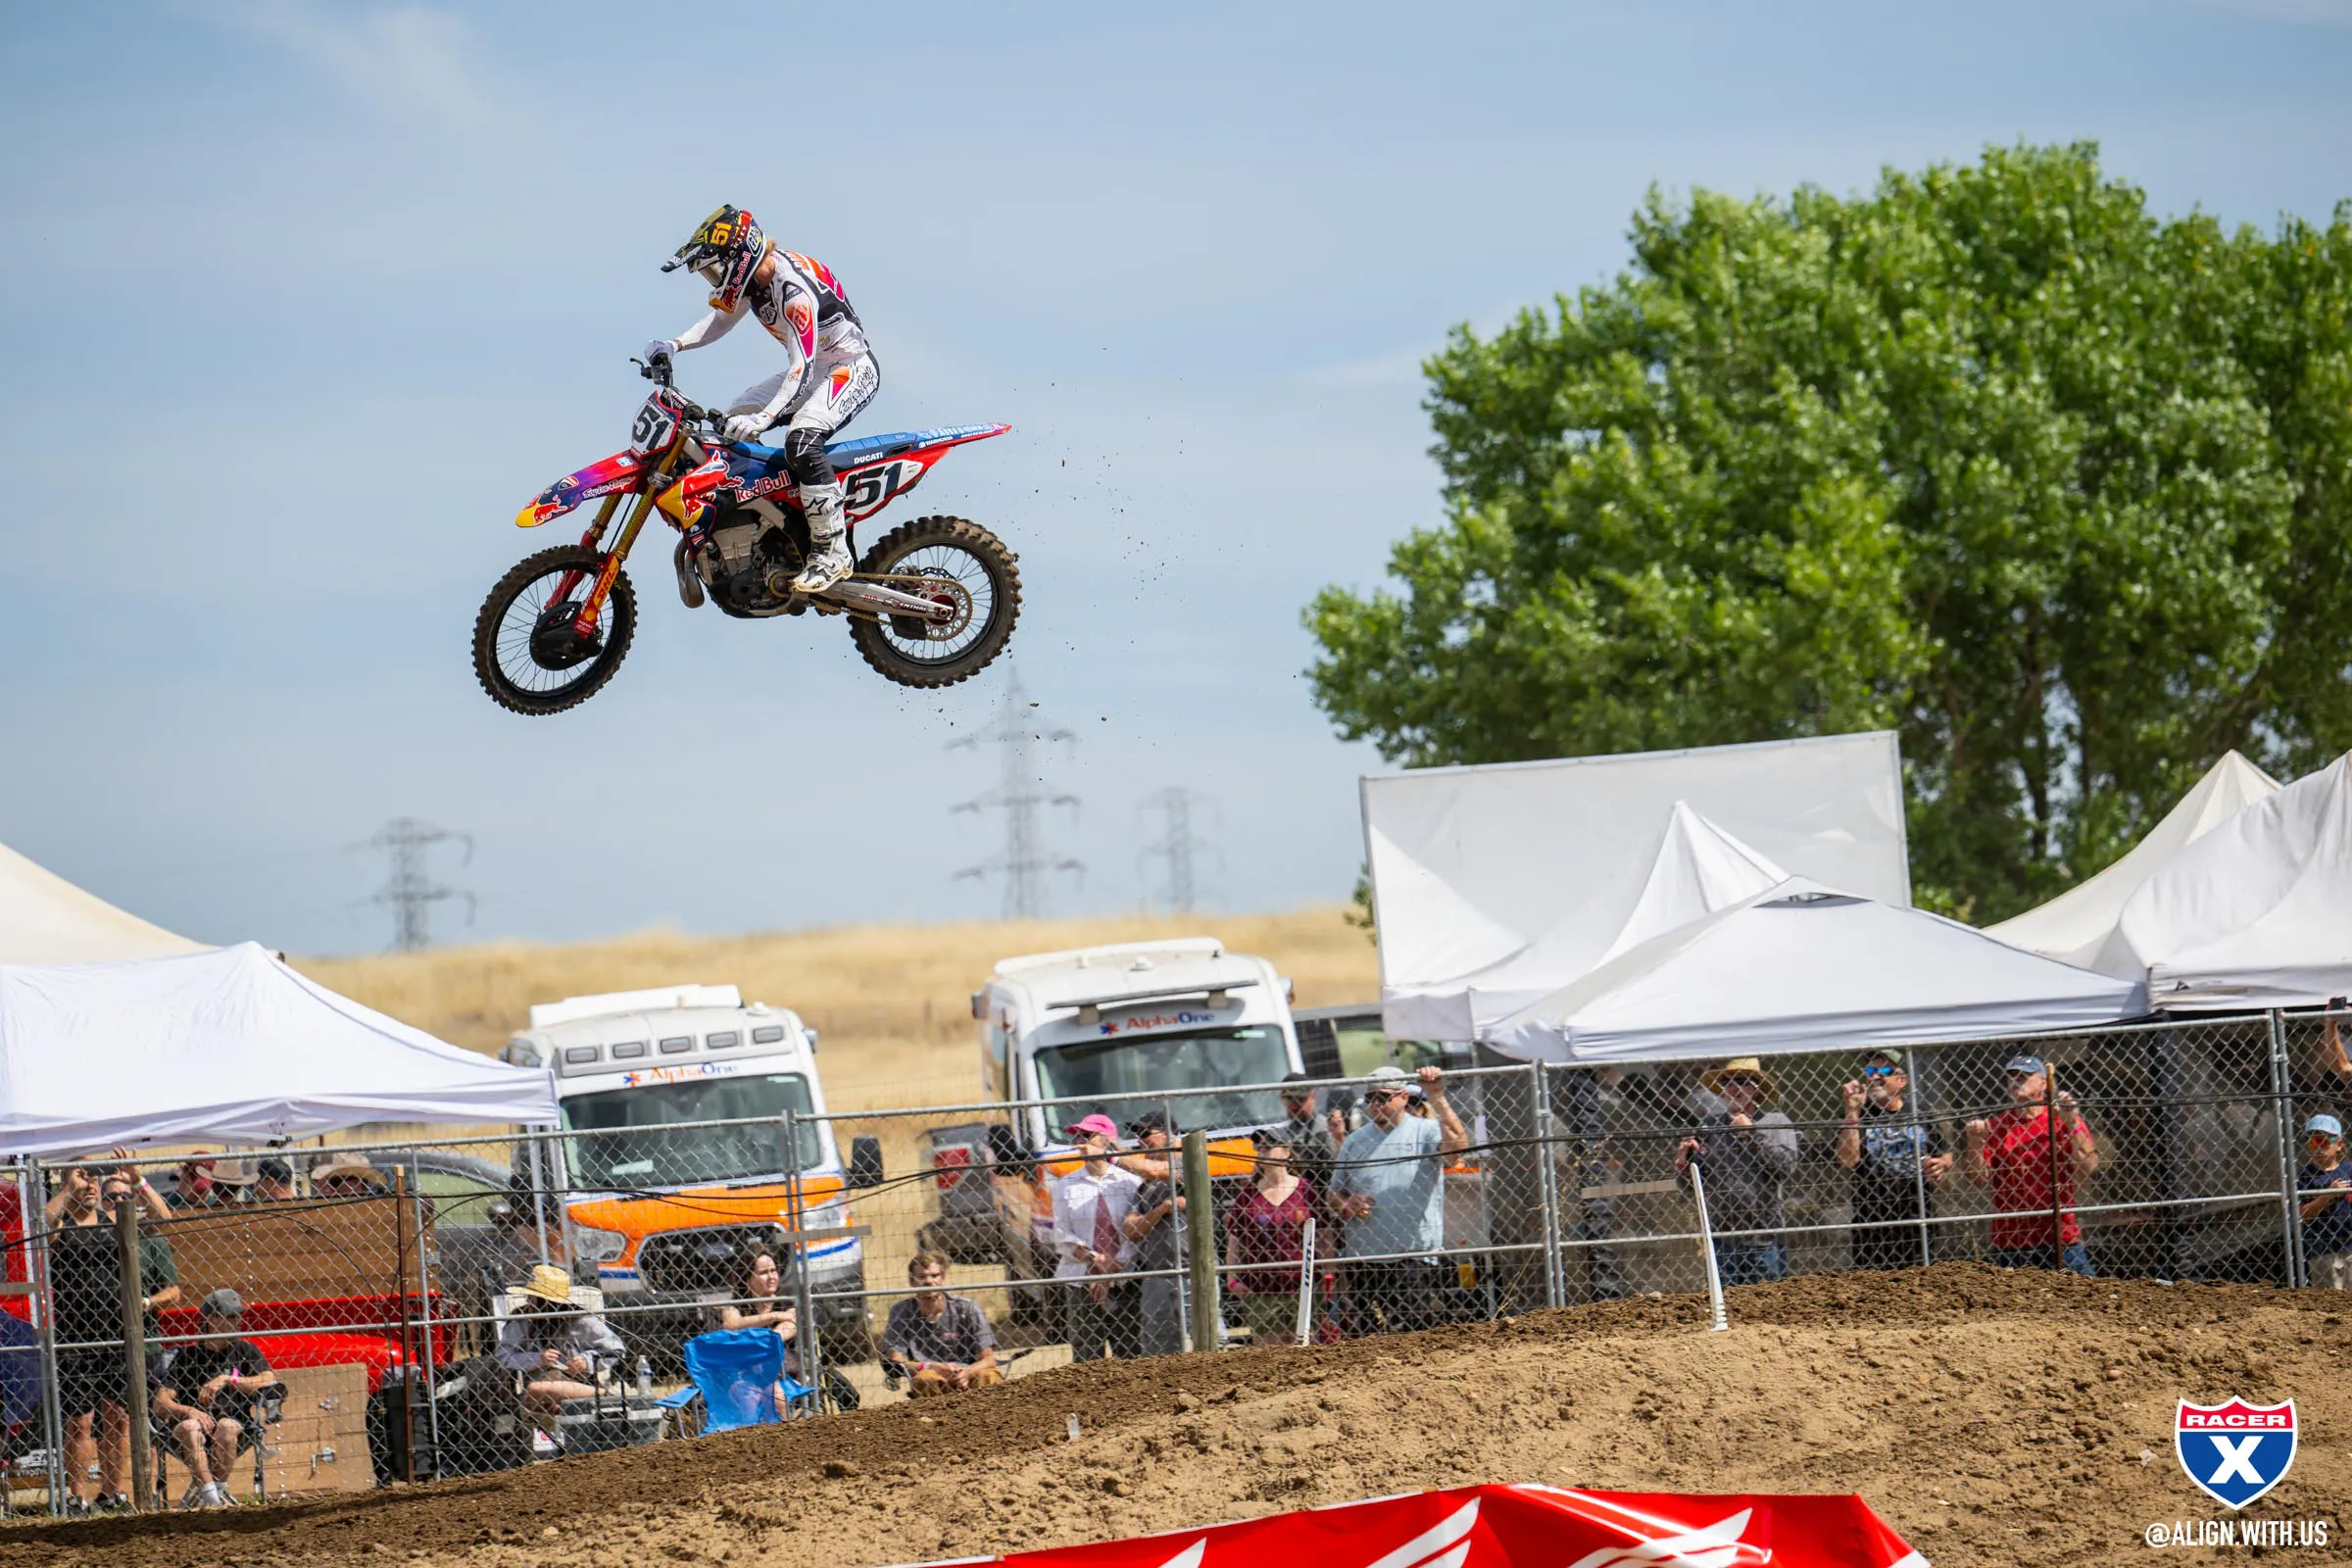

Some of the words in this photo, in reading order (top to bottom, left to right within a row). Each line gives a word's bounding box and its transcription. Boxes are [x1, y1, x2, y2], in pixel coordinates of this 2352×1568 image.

[710, 221, 732, 245] 51
[633, 405, 670, 451] 51
[854, 452, 884, 466] DUCATI
[735, 480, 761, 503] Red
[761, 469, 792, 493] Bull
[845, 463, 904, 511] 51
[596, 570, 616, 601] DHL
[1126, 1010, 1216, 1030] AlphaOne
